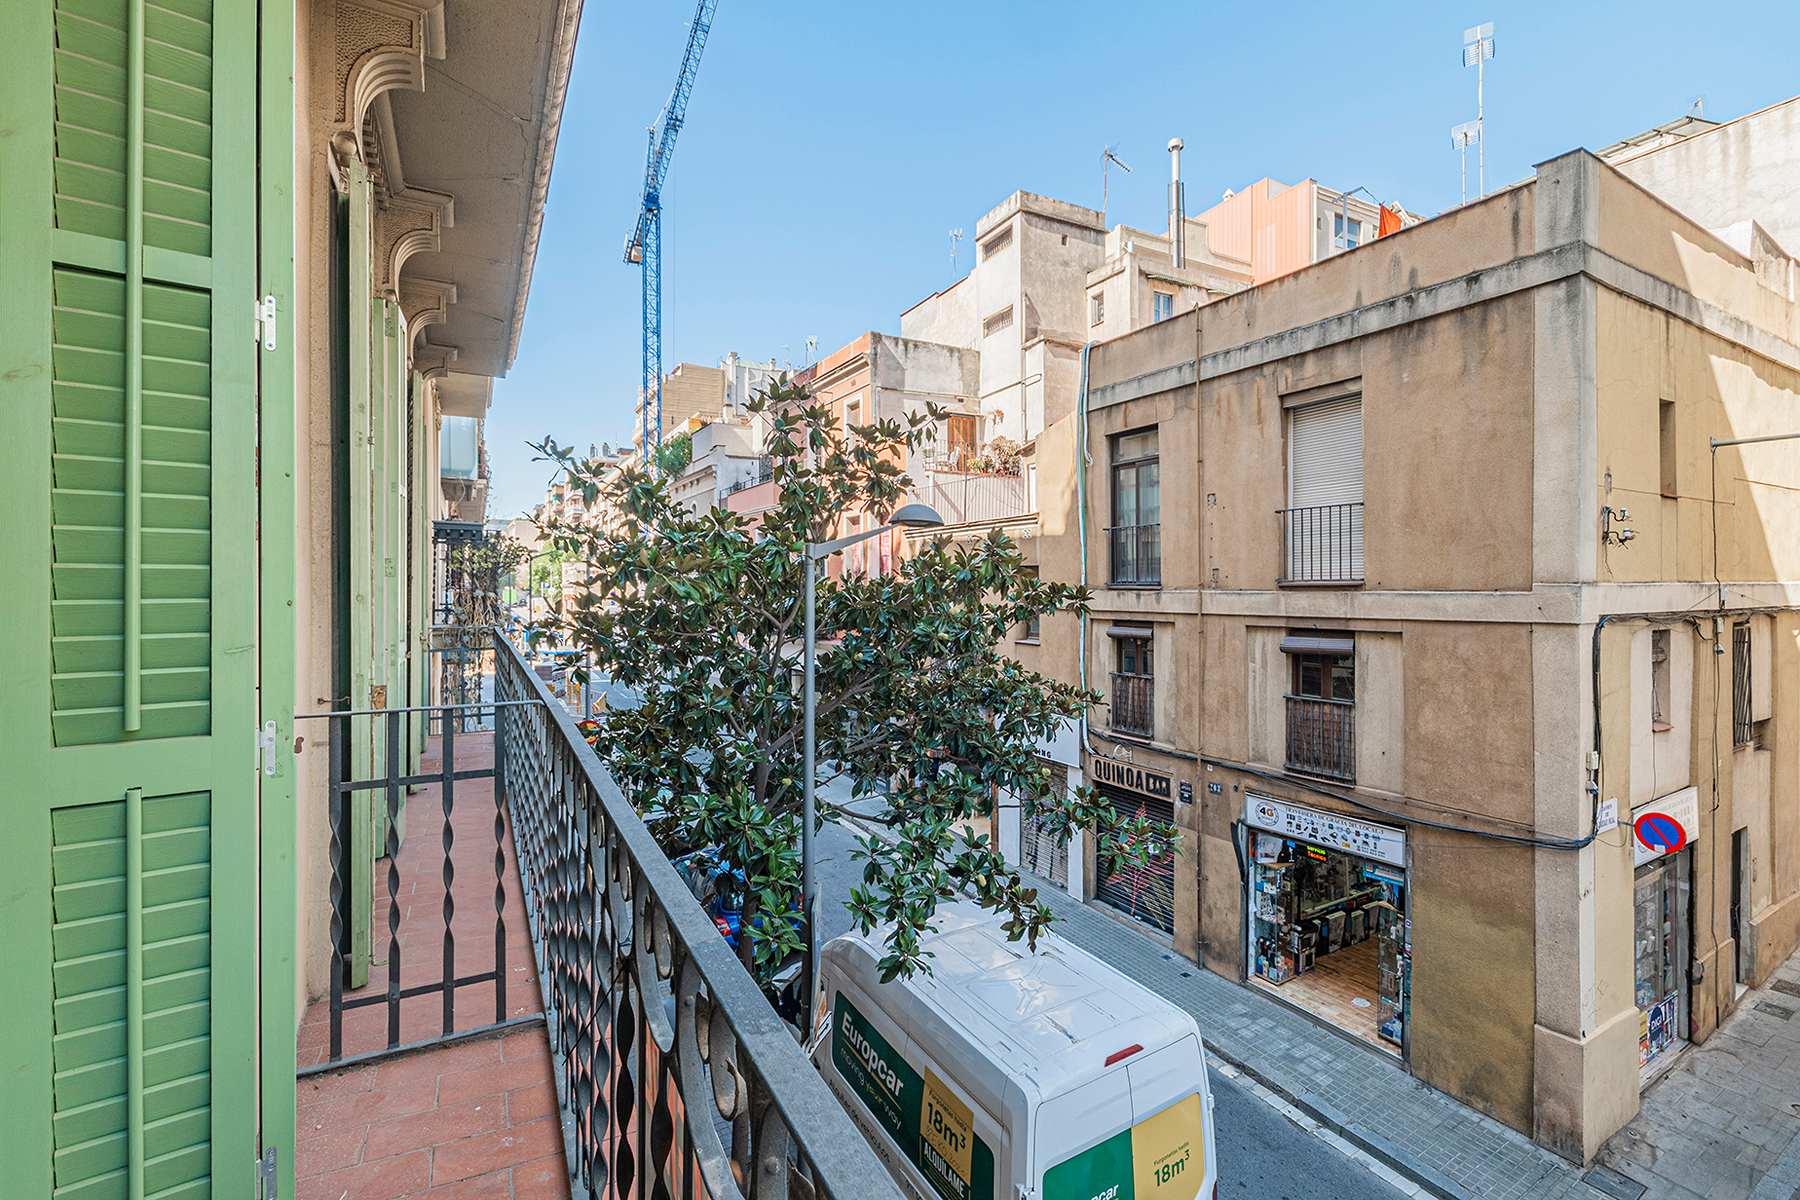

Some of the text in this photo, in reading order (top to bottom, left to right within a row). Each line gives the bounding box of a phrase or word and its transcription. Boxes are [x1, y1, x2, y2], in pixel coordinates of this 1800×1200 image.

[1095, 759, 1167, 794] QUINOA BAR
[1259, 806, 1274, 818] 4G
[1651, 1015, 1662, 1030] DIGI
[842, 1011, 904, 1097] Europcar
[841, 1048, 902, 1130] moving your way
[928, 1089, 967, 1133] Furgonetas hasta
[1153, 1141, 1189, 1166] Furgonetas hasta
